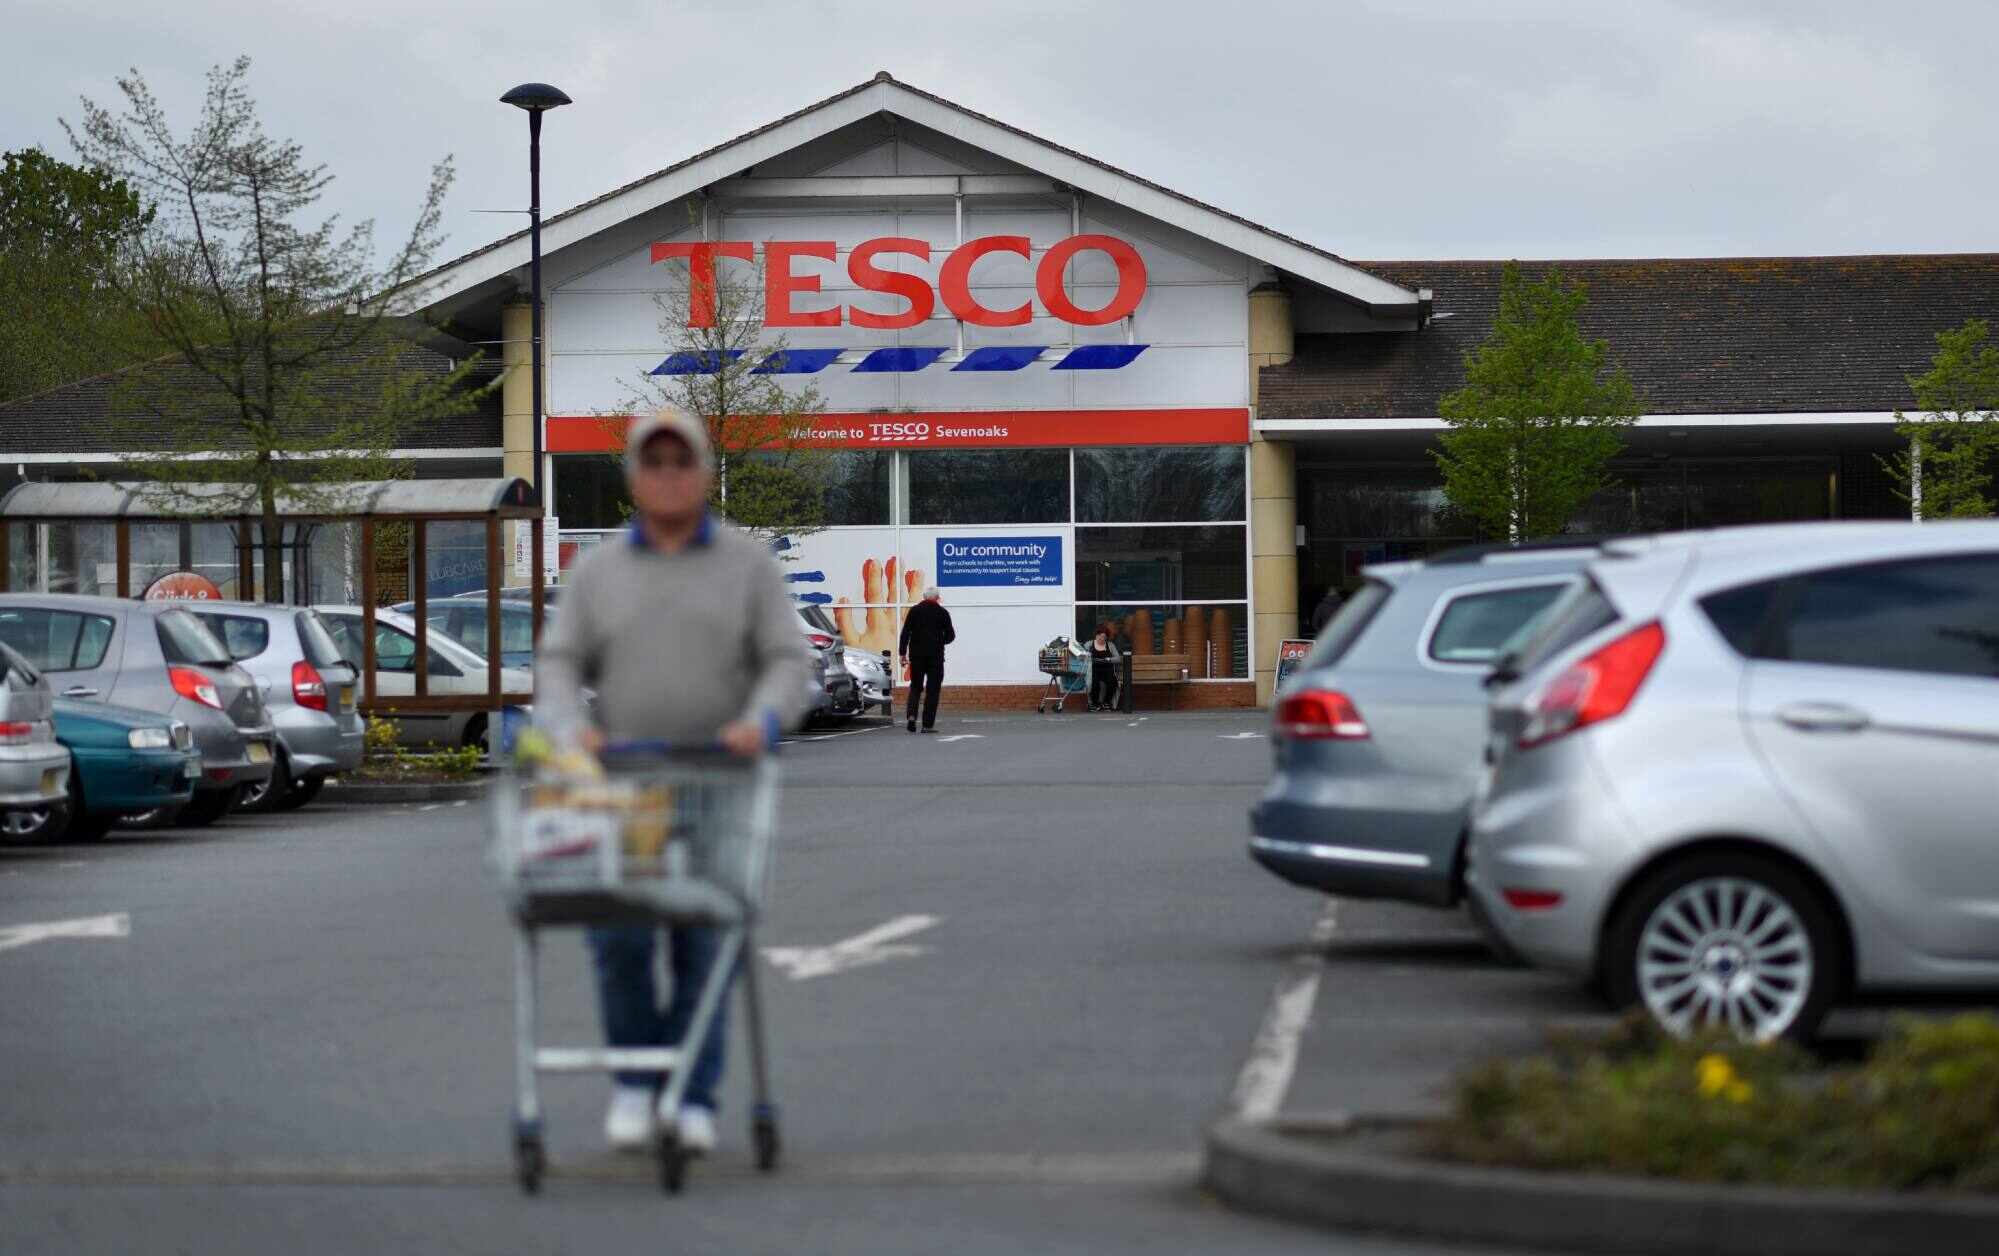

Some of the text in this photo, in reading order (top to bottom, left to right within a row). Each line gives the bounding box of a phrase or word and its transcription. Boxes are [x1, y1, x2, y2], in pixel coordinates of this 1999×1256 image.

[651, 235, 1147, 329] TESCO
[850, 428, 864, 439] to
[869, 423, 929, 436] TESCO
[936, 426, 1008, 438] Sevenoaks
[943, 543, 1047, 558] Our community
